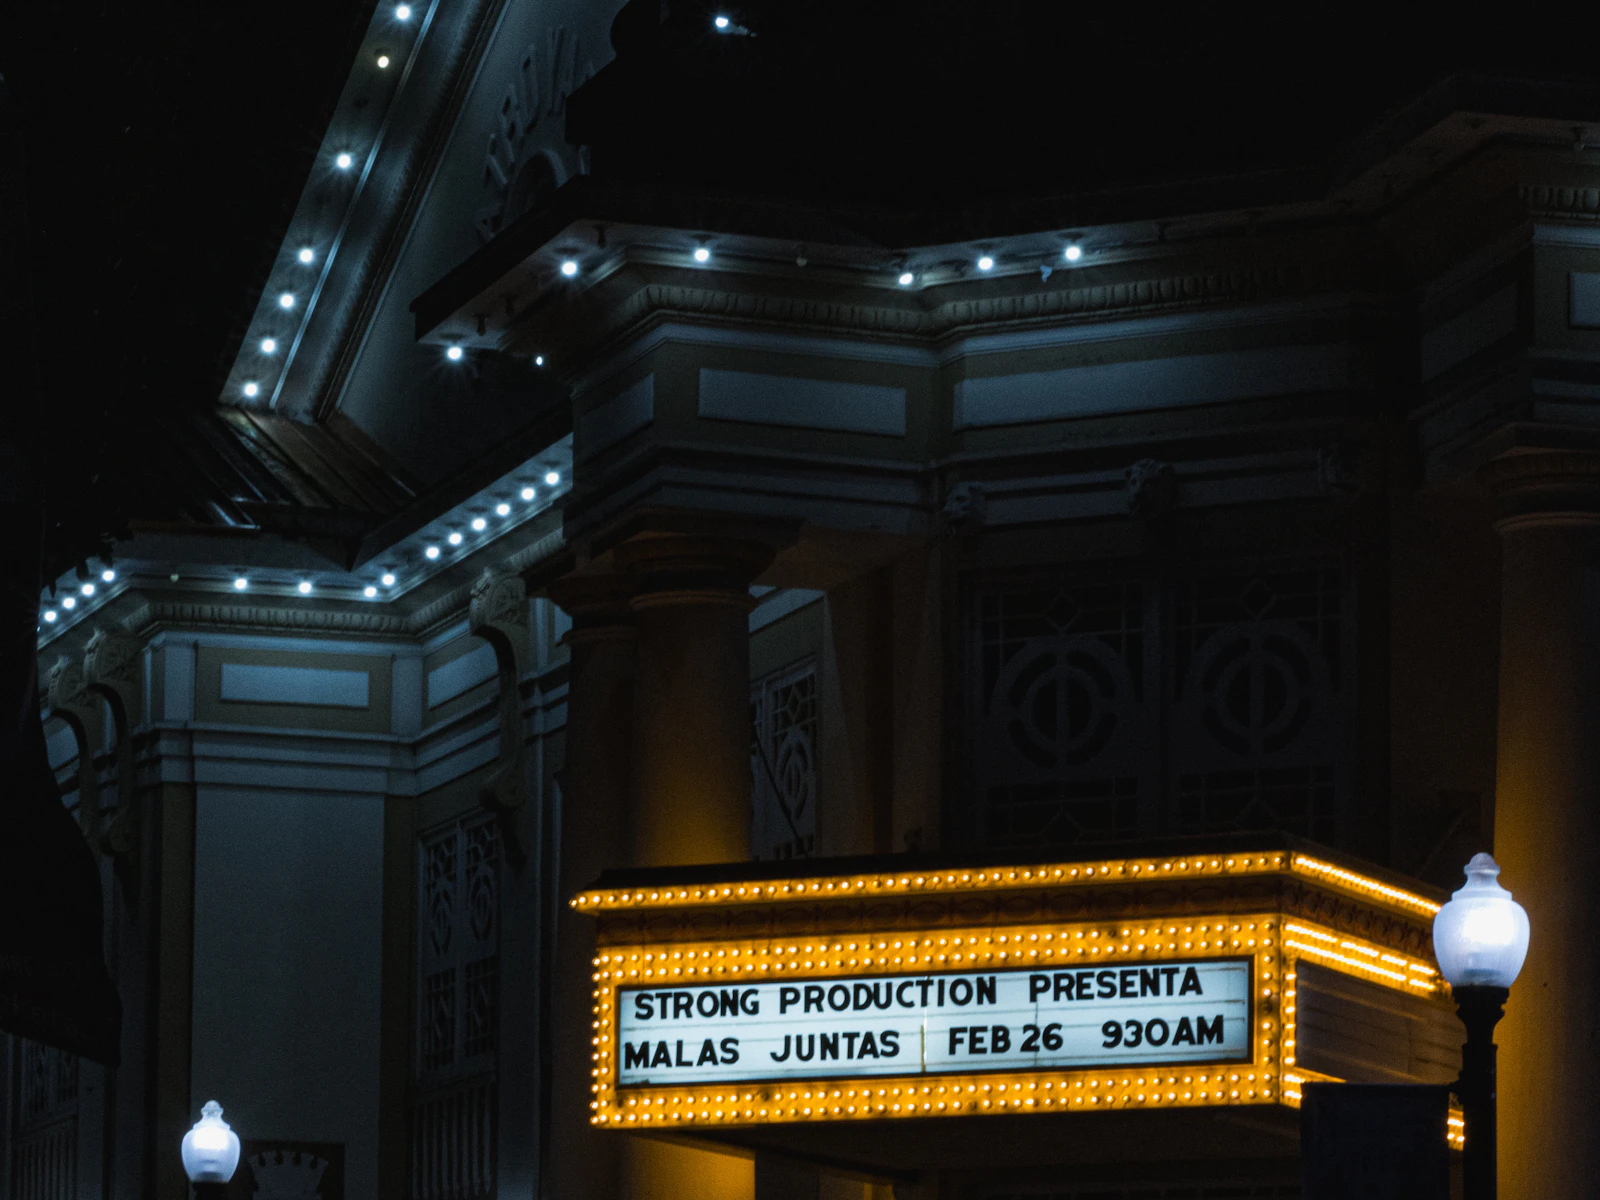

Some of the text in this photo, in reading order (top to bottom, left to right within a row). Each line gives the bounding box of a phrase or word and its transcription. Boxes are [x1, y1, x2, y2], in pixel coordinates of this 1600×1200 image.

[634, 966, 1203, 1020] STRONG PRODUCTION PRESENTA
[624, 1014, 1224, 1070] MALAS JUNTAS FEB 26 930AM
